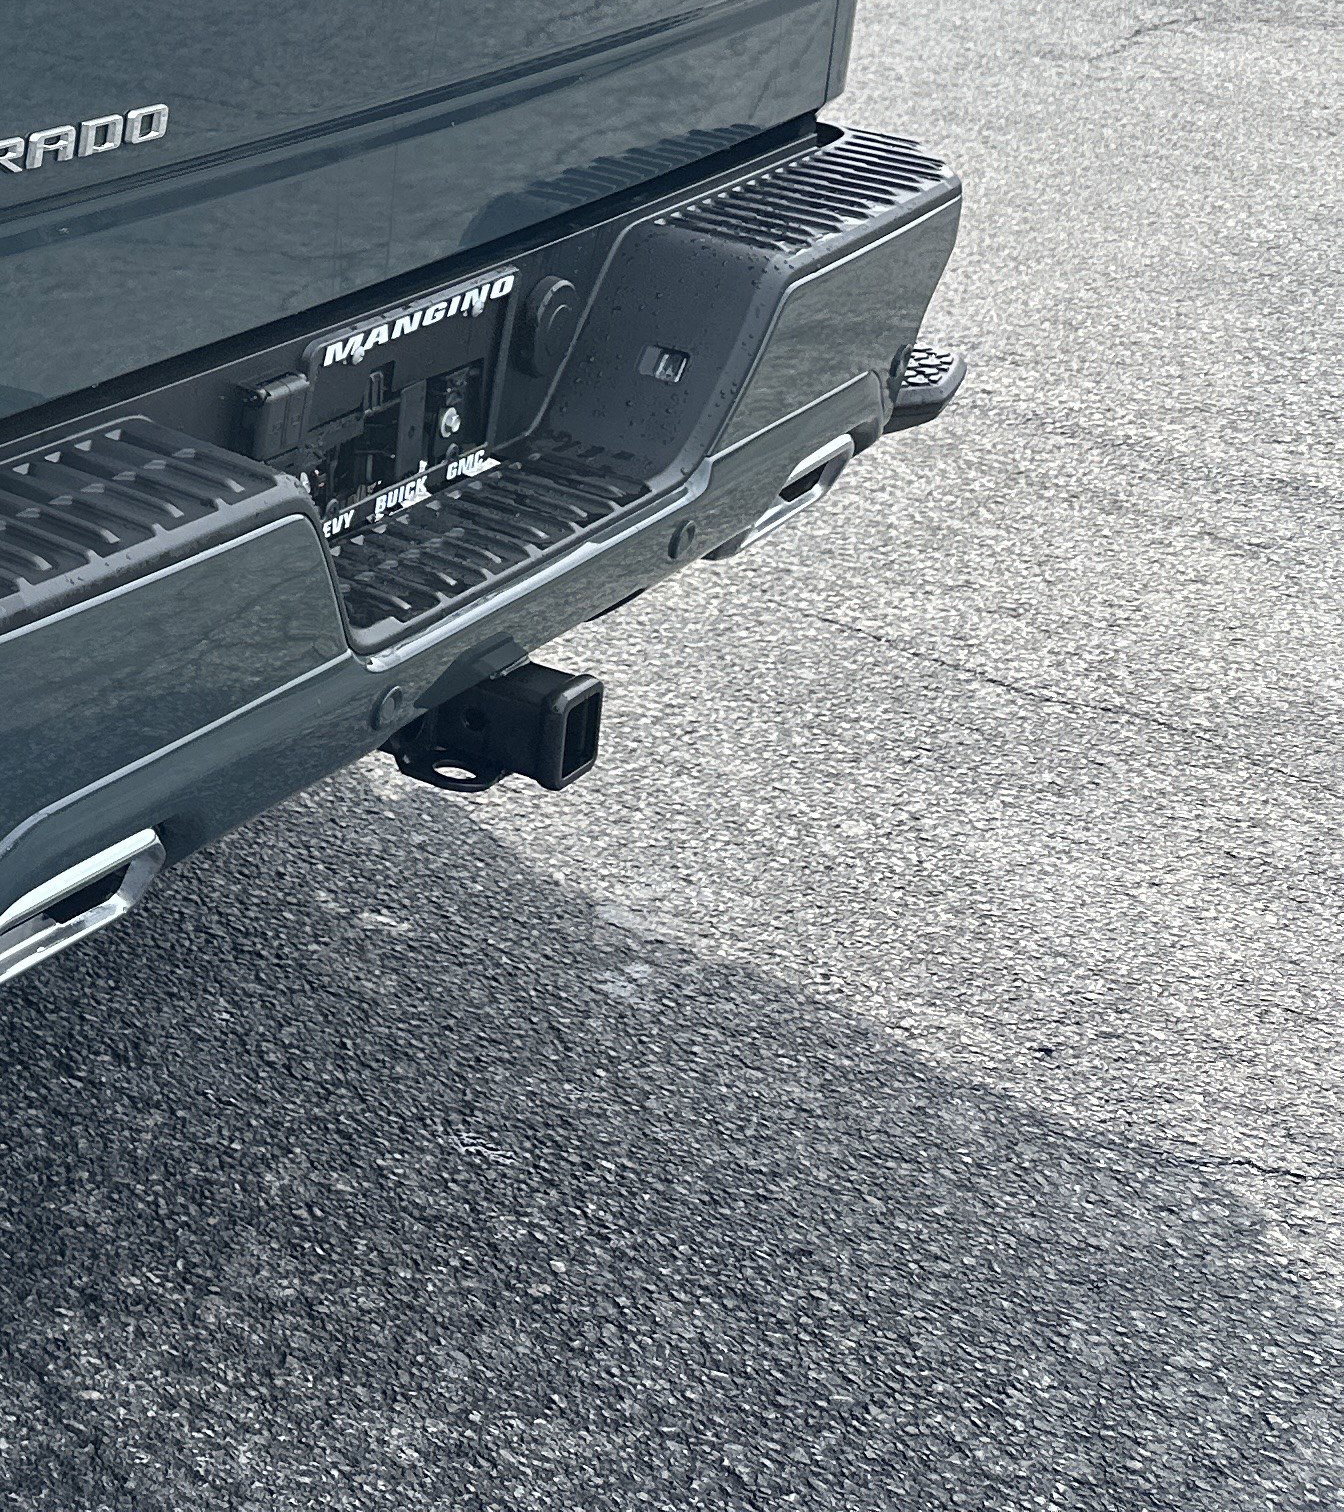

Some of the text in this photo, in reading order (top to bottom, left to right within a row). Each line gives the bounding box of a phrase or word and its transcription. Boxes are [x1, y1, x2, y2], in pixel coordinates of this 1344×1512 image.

[322, 274, 516, 368] MANGINO
[322, 448, 486, 539] EVY BUICK GMC
